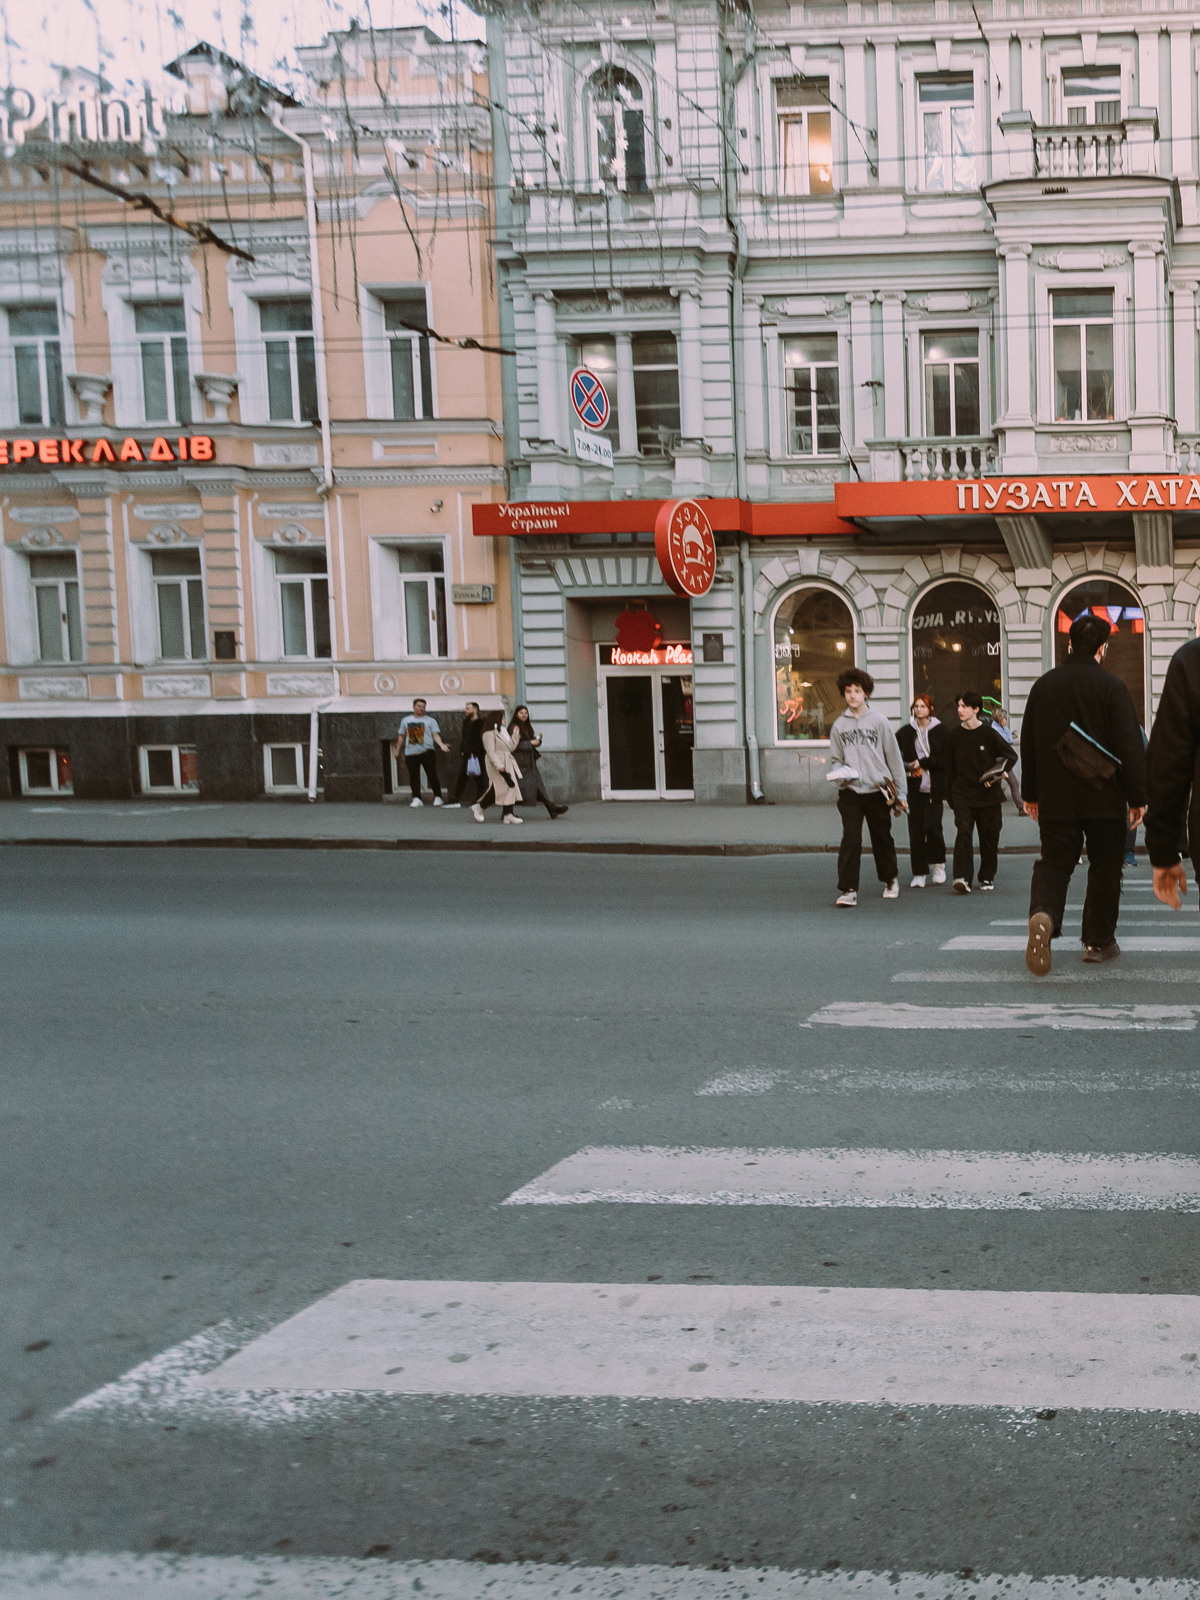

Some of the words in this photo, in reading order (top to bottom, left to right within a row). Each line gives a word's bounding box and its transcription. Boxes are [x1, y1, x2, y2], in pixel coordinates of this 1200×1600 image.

[0, 86, 165, 142] Print
[956, 481, 1097, 510] ПУЗАТА
[498, 503, 570, 520] Українські
[511, 519, 557, 533] страви
[672, 506, 712, 555] ПУЗАТА
[681, 564, 710, 589] ХАТА
[611, 647, 659, 665] Hookah
[665, 644, 693, 665] Plac
